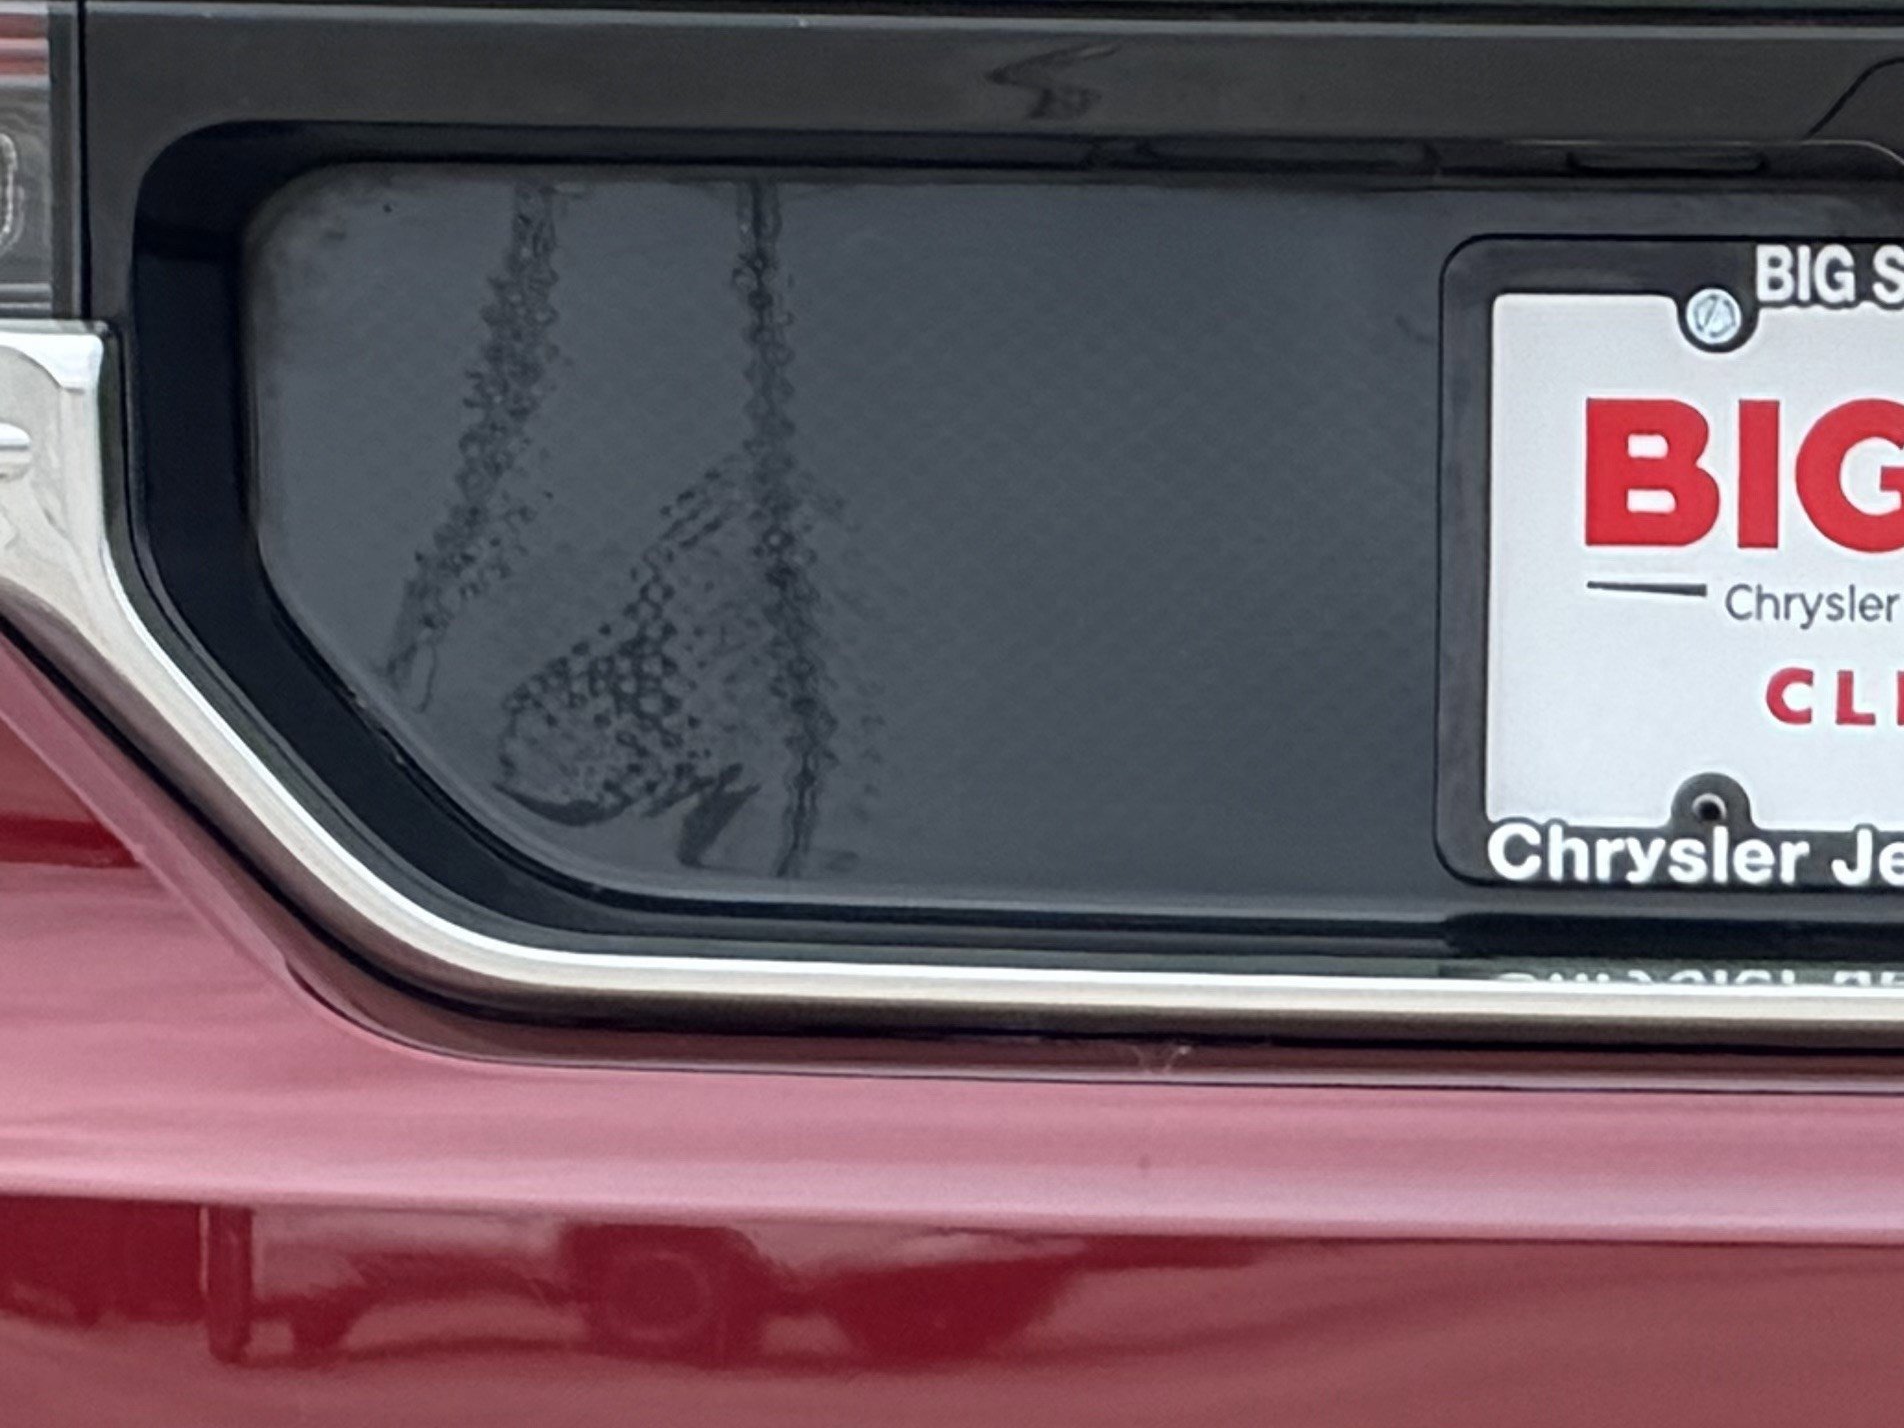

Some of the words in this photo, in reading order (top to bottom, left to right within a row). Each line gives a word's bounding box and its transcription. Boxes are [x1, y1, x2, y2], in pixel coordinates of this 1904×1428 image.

[1755, 244, 1856, 303] BIG
[1725, 584, 1899, 630] Chrysler
[1487, 822, 1809, 884] Chrysler
